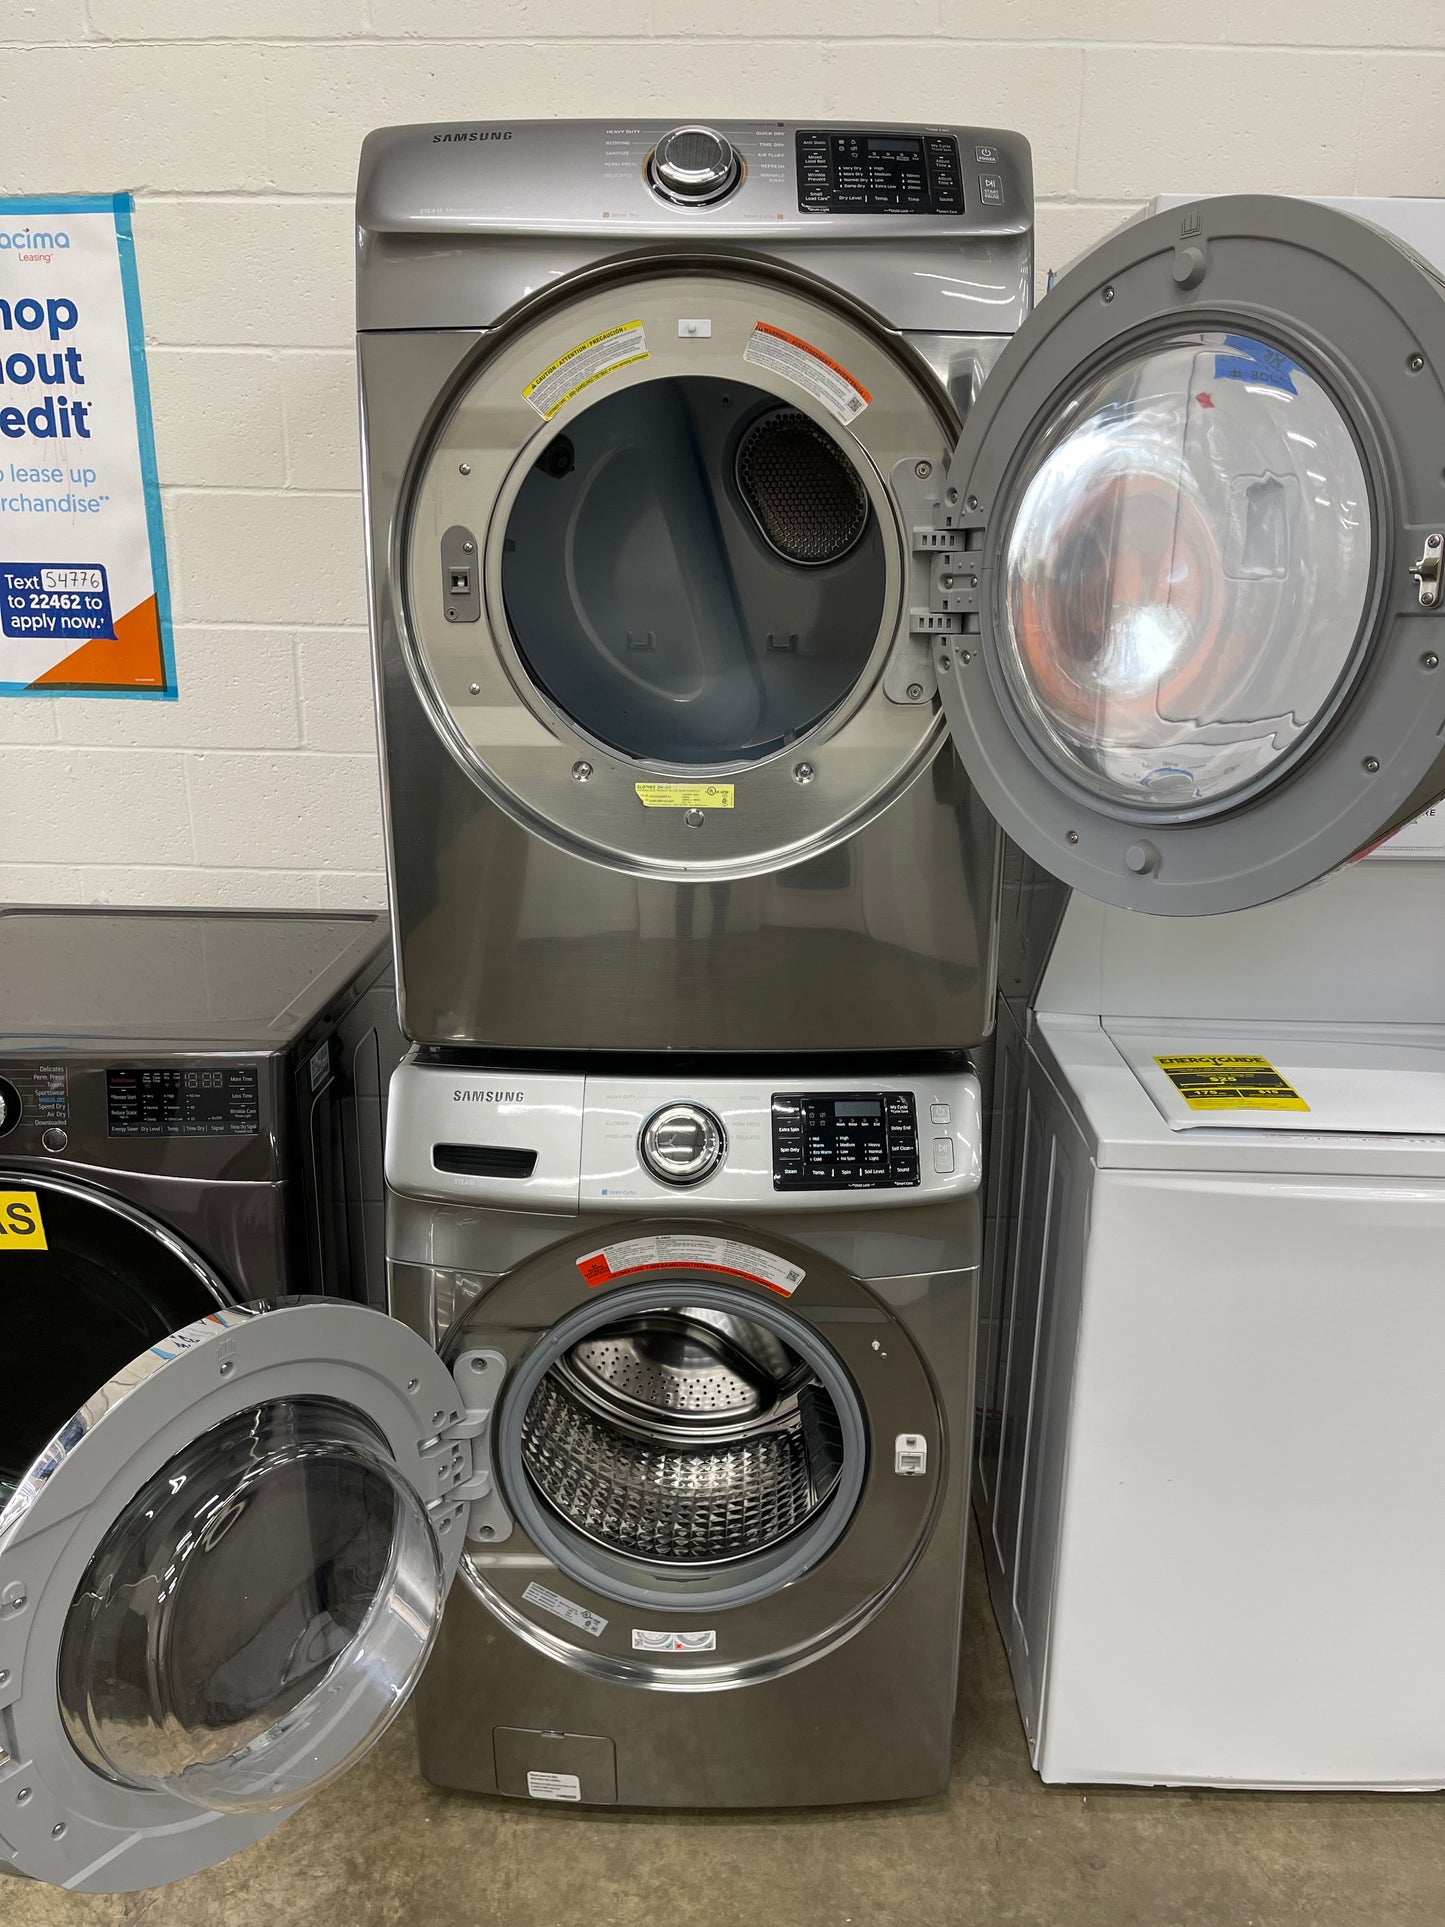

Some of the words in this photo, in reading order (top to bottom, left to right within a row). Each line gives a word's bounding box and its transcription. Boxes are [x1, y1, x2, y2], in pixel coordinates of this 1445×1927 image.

[432, 131, 513, 143] SAMSUNG
[0, 347, 85, 385] out
[536, 365, 557, 384] CAUTION
[559, 344, 587, 366] ATTENTION
[10, 464, 63, 483] lease
[69, 468, 96, 487] up
[4, 574, 40, 590] Text
[46, 571, 100, 589] 54776
[7, 595, 26, 609] to
[29, 594, 81, 610] 22462
[84, 596, 103, 610] to
[11, 613, 56, 631] apply
[453, 1090, 525, 1102] SAMSUNG
